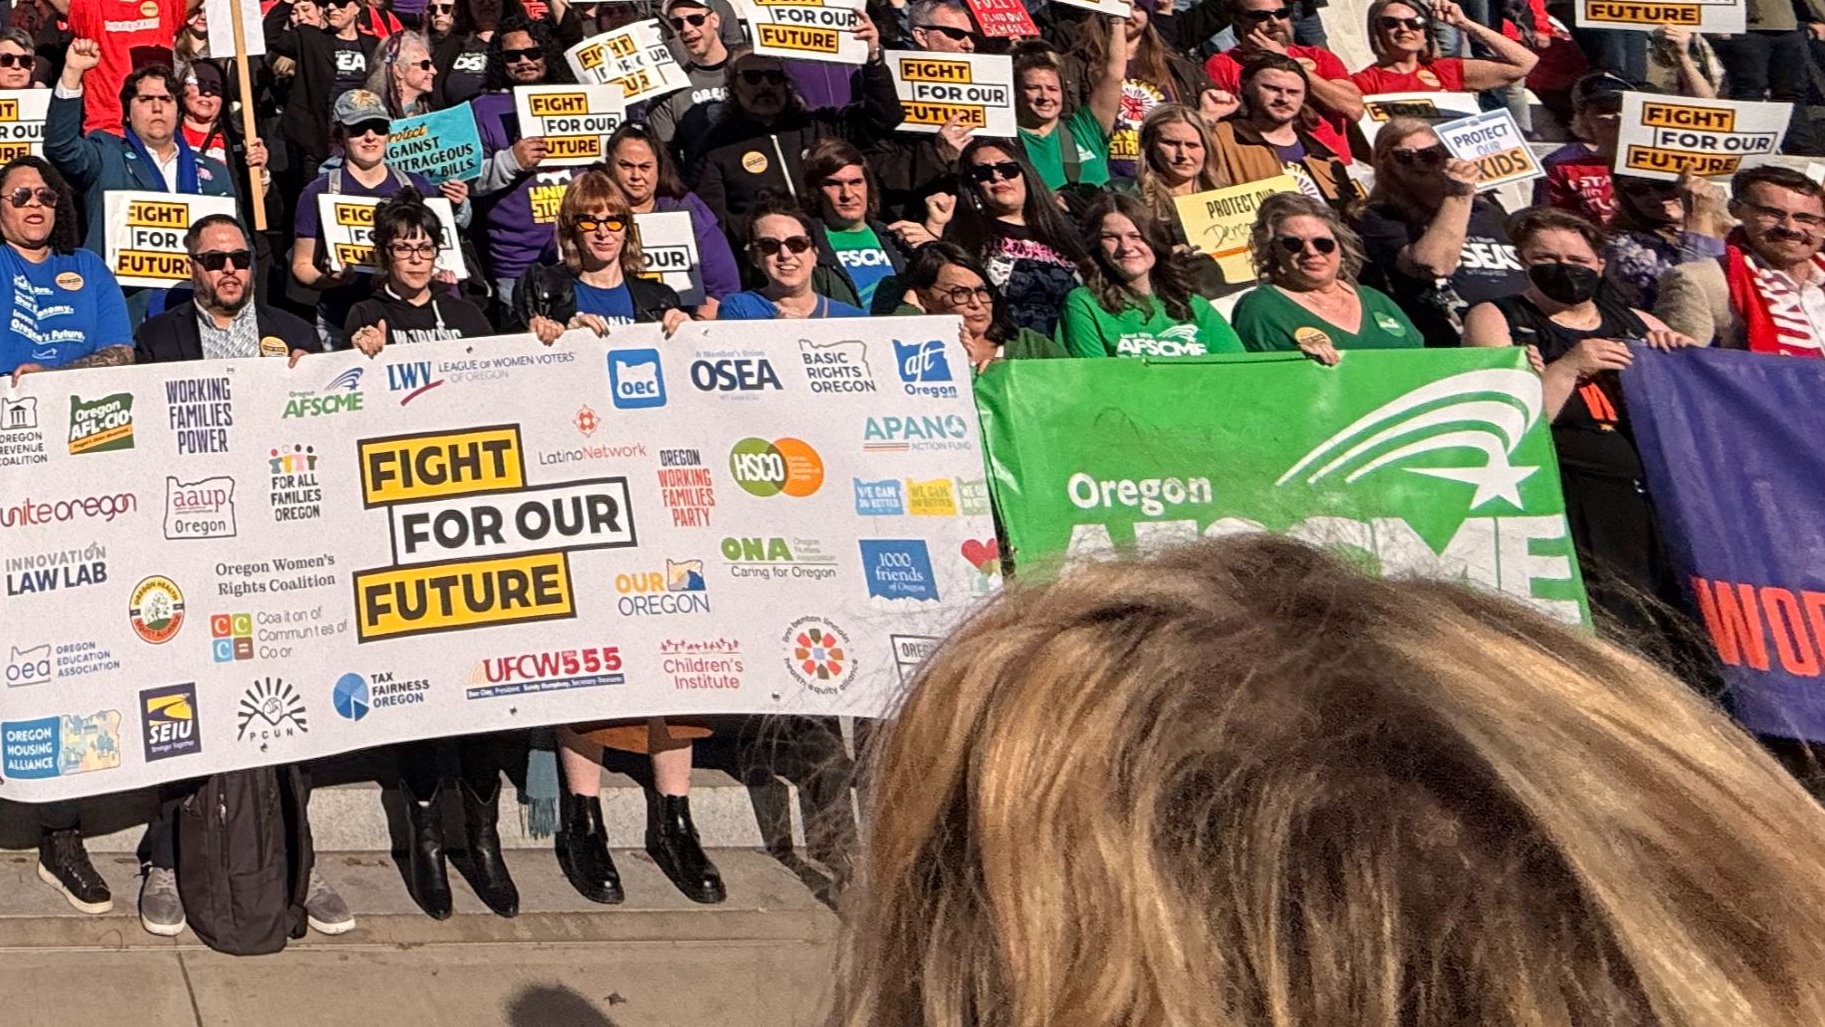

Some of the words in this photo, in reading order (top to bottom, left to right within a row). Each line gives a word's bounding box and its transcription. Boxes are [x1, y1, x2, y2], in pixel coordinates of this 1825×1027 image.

[1589, 4, 1698, 23] FUTURE
[438, 361, 479, 373] LEAGUE
[492, 356, 534, 369] WOMEN
[535, 353, 575, 365] VOTERS
[803, 352, 848, 365] BASIC
[905, 341, 942, 373] aft
[386, 360, 433, 391] LWV
[691, 359, 783, 392] OSEA
[807, 366, 862, 378] RIGHTS
[166, 377, 231, 404] WORKING
[621, 379, 656, 396] oec
[810, 379, 877, 393] OREGON
[904, 383, 957, 398] Oregon
[75, 401, 121, 424] Oregon
[281, 390, 364, 420] AFSCME
[169, 403, 233, 430] FAMILIES
[864, 414, 967, 440] APANO
[177, 430, 229, 454] POWER
[911, 441, 946, 451] ACTION
[947, 441, 972, 450] FUND
[369, 439, 512, 492] FIGHT
[660, 449, 702, 467] OREGON
[734, 452, 784, 483] HSCO
[271, 477, 294, 491] FOR
[296, 475, 318, 488] ALL
[658, 468, 713, 488] WORKING
[174, 487, 226, 513] aaup
[270, 489, 322, 506] FAMILIES
[663, 487, 716, 508] FAMILIES
[1066, 472, 1213, 516] Oregon
[275, 504, 321, 521] OREGON
[673, 508, 713, 527] PARTY
[175, 519, 226, 537] Oregon
[402, 505, 506, 553] FOR
[515, 493, 623, 536] OUR
[721, 537, 794, 561] ONA
[6, 546, 107, 573] INNOVATION
[215, 559, 270, 580] Oregon
[273, 553, 335, 572] Women's
[879, 552, 912, 568] 1000
[7, 565, 61, 597] LAW
[63, 561, 107, 587] LAB
[731, 565, 771, 579] Caring
[773, 565, 790, 577] for
[792, 566, 837, 579] Oregon
[875, 567, 924, 583] friends
[218, 578, 267, 598] Rights
[268, 572, 336, 593] Coalition
[615, 572, 665, 595] OUR
[365, 564, 563, 626] FUTURE
[617, 592, 710, 616] OREGON
[56, 641, 97, 655] OREGON
[57, 650, 111, 666] EDUCATION
[663, 657, 744, 674] Children's
[6, 658, 51, 683] oea
[57, 660, 121, 678] ASSOCIATION
[371, 672, 394, 683] TAX
[372, 679, 430, 696] FAIRNESS
[674, 674, 740, 690] Institute
[373, 693, 424, 707] OREGON
[6, 728, 52, 743] OREGON
[149, 721, 193, 745] SEIU
[7, 743, 53, 756] HOUSING
[8, 757, 54, 770] ALLIANCE
